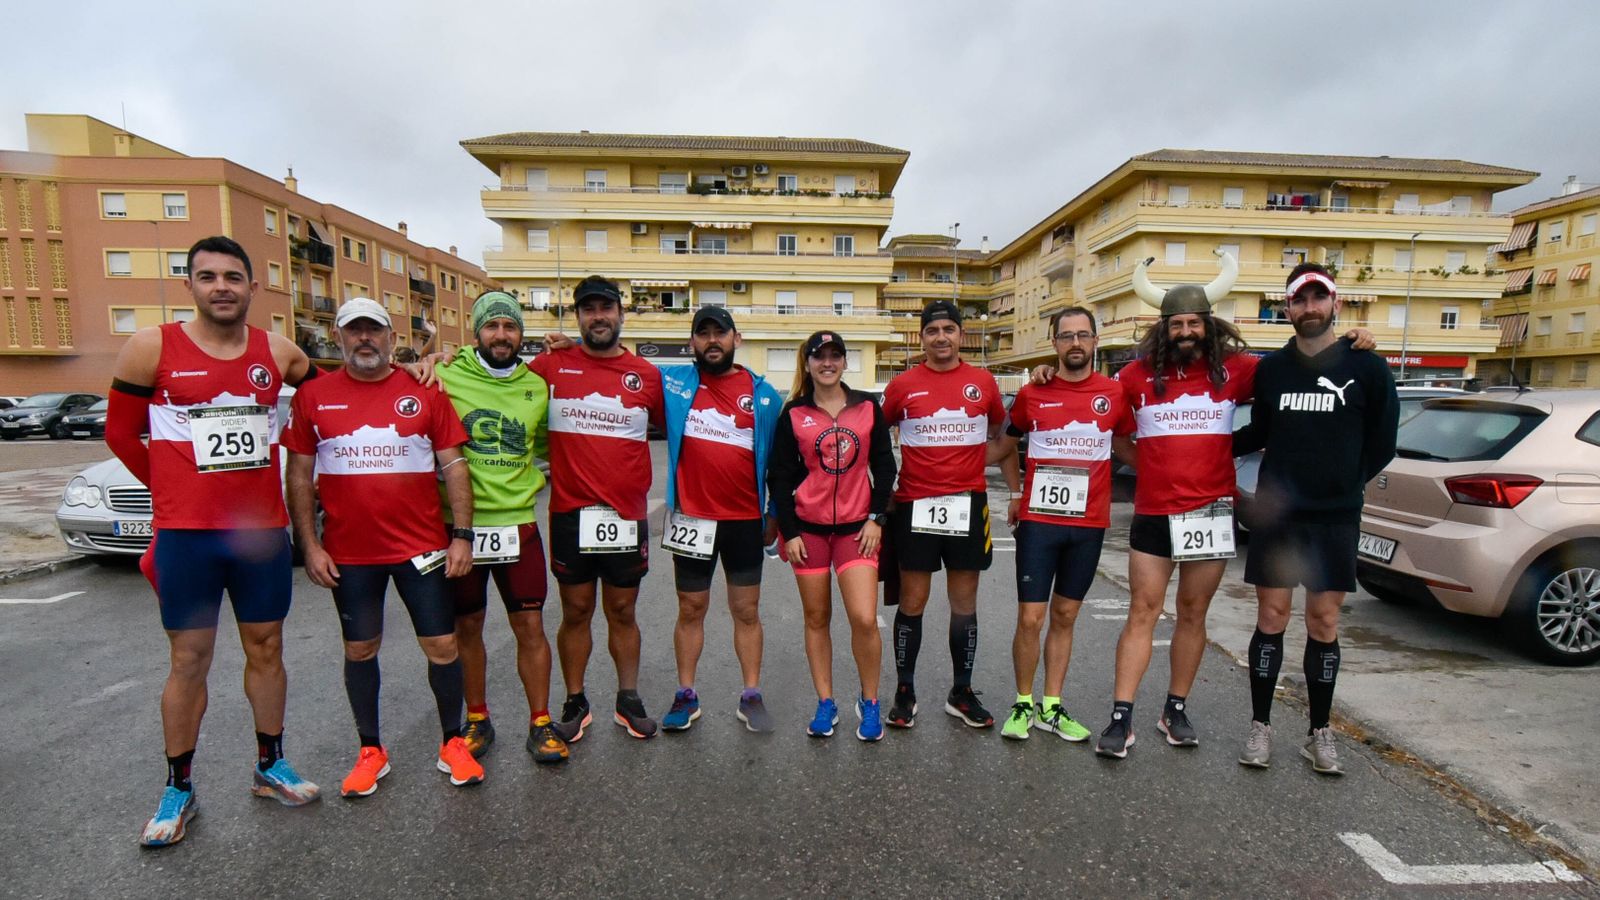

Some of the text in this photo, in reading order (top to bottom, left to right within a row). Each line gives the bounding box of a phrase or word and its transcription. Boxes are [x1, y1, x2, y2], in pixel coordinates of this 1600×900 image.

[1279, 392, 1335, 412] PUMA
[221, 417, 248, 427] DIDIER
[561, 407, 632, 426] SAN ROQUE
[1154, 409, 1223, 422] SAN ROQUE
[575, 420, 616, 432] RUNNING
[693, 425, 730, 439] RUNNING
[914, 423, 977, 434] SAN ROQUE
[1168, 421, 1208, 431] RUNNING
[207, 431, 255, 458] 259
[927, 434, 965, 443] RUNNING
[1045, 437, 1105, 448] SAN ROQUE
[333, 445, 410, 458] SAN ROQUE
[1057, 447, 1093, 457] RUNNING
[348, 459, 394, 469] RUNNING
[1039, 485, 1070, 505] 150
[928, 506, 948, 525] 13
[121, 521, 153, 535] 9223
[596, 523, 618, 542] 69
[670, 524, 698, 547] 222
[476, 532, 501, 552] 78
[1183, 529, 1214, 550] 291
[1371, 538, 1393, 558] KNK
[1255, 642, 1276, 678] alenji
[1318, 652, 1338, 682] lenji
